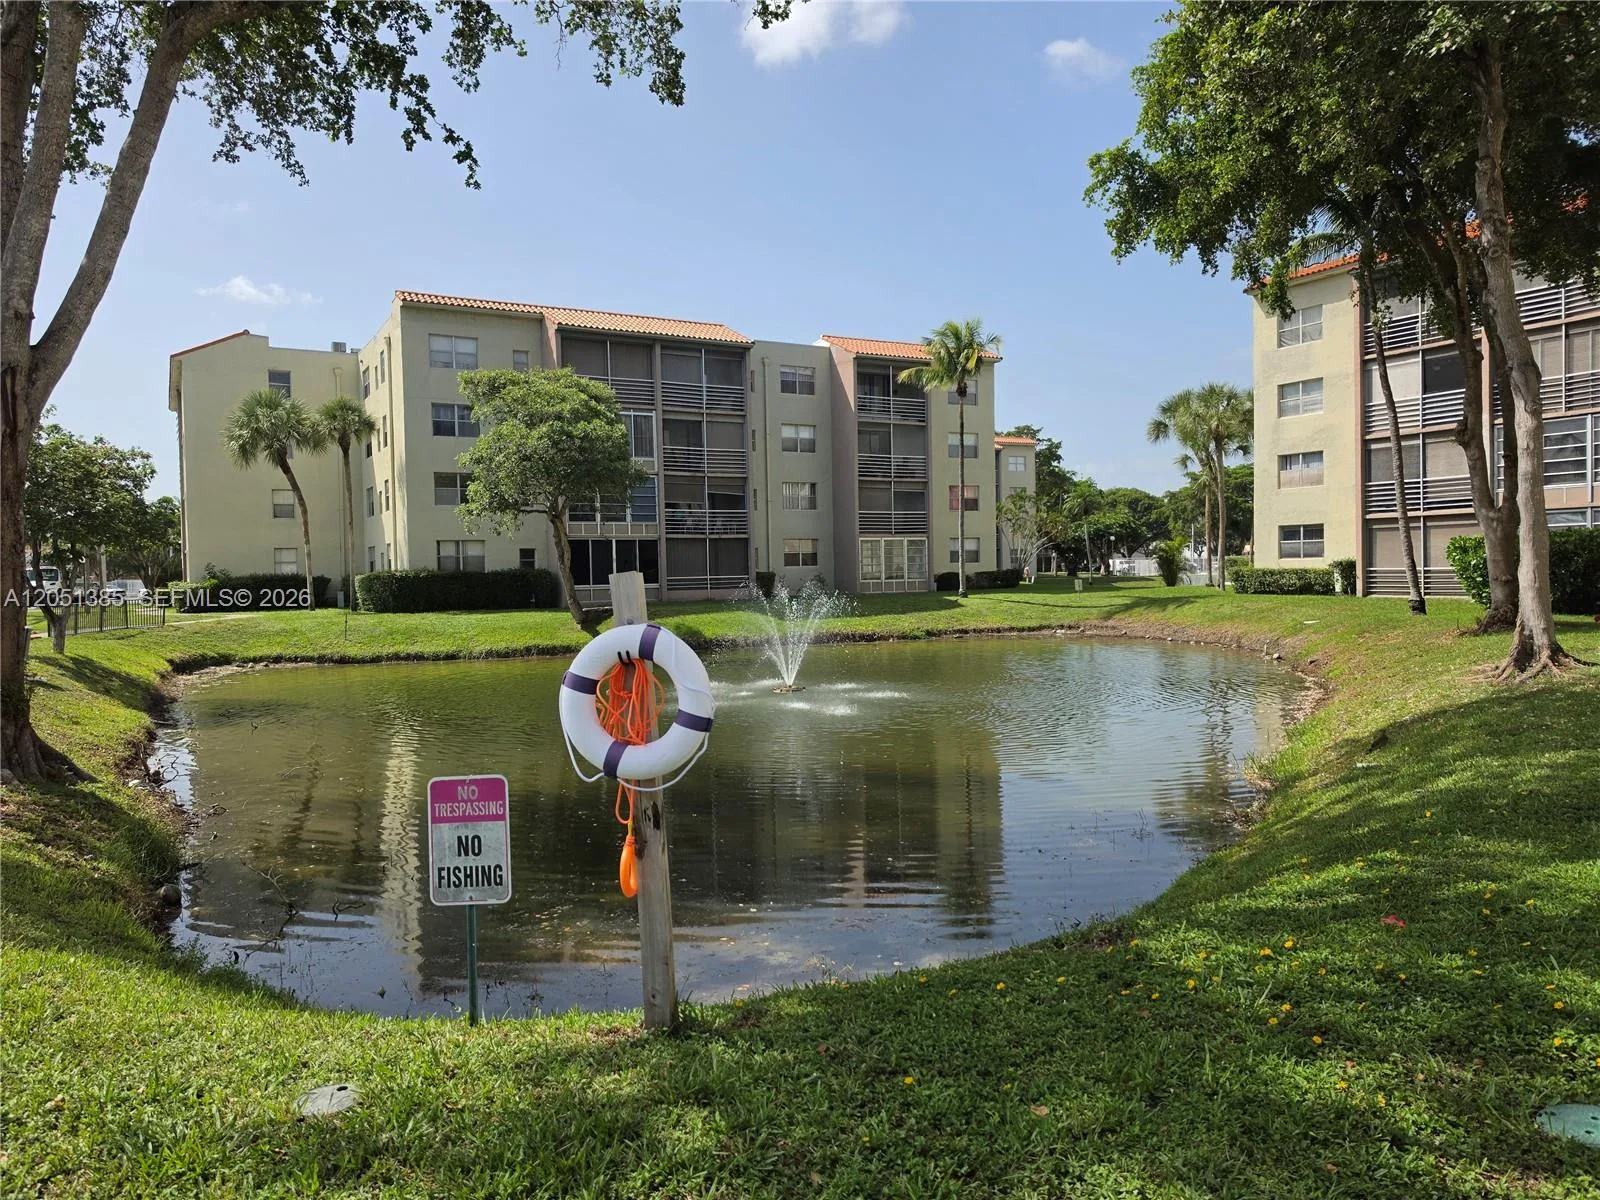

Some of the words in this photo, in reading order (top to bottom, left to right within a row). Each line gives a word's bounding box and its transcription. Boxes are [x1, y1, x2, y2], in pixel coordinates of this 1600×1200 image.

[457, 785, 479, 800] NO
[434, 801, 504, 817] TRESPASSING
[457, 834, 482, 856] NO
[437, 864, 503, 889] FISHING
